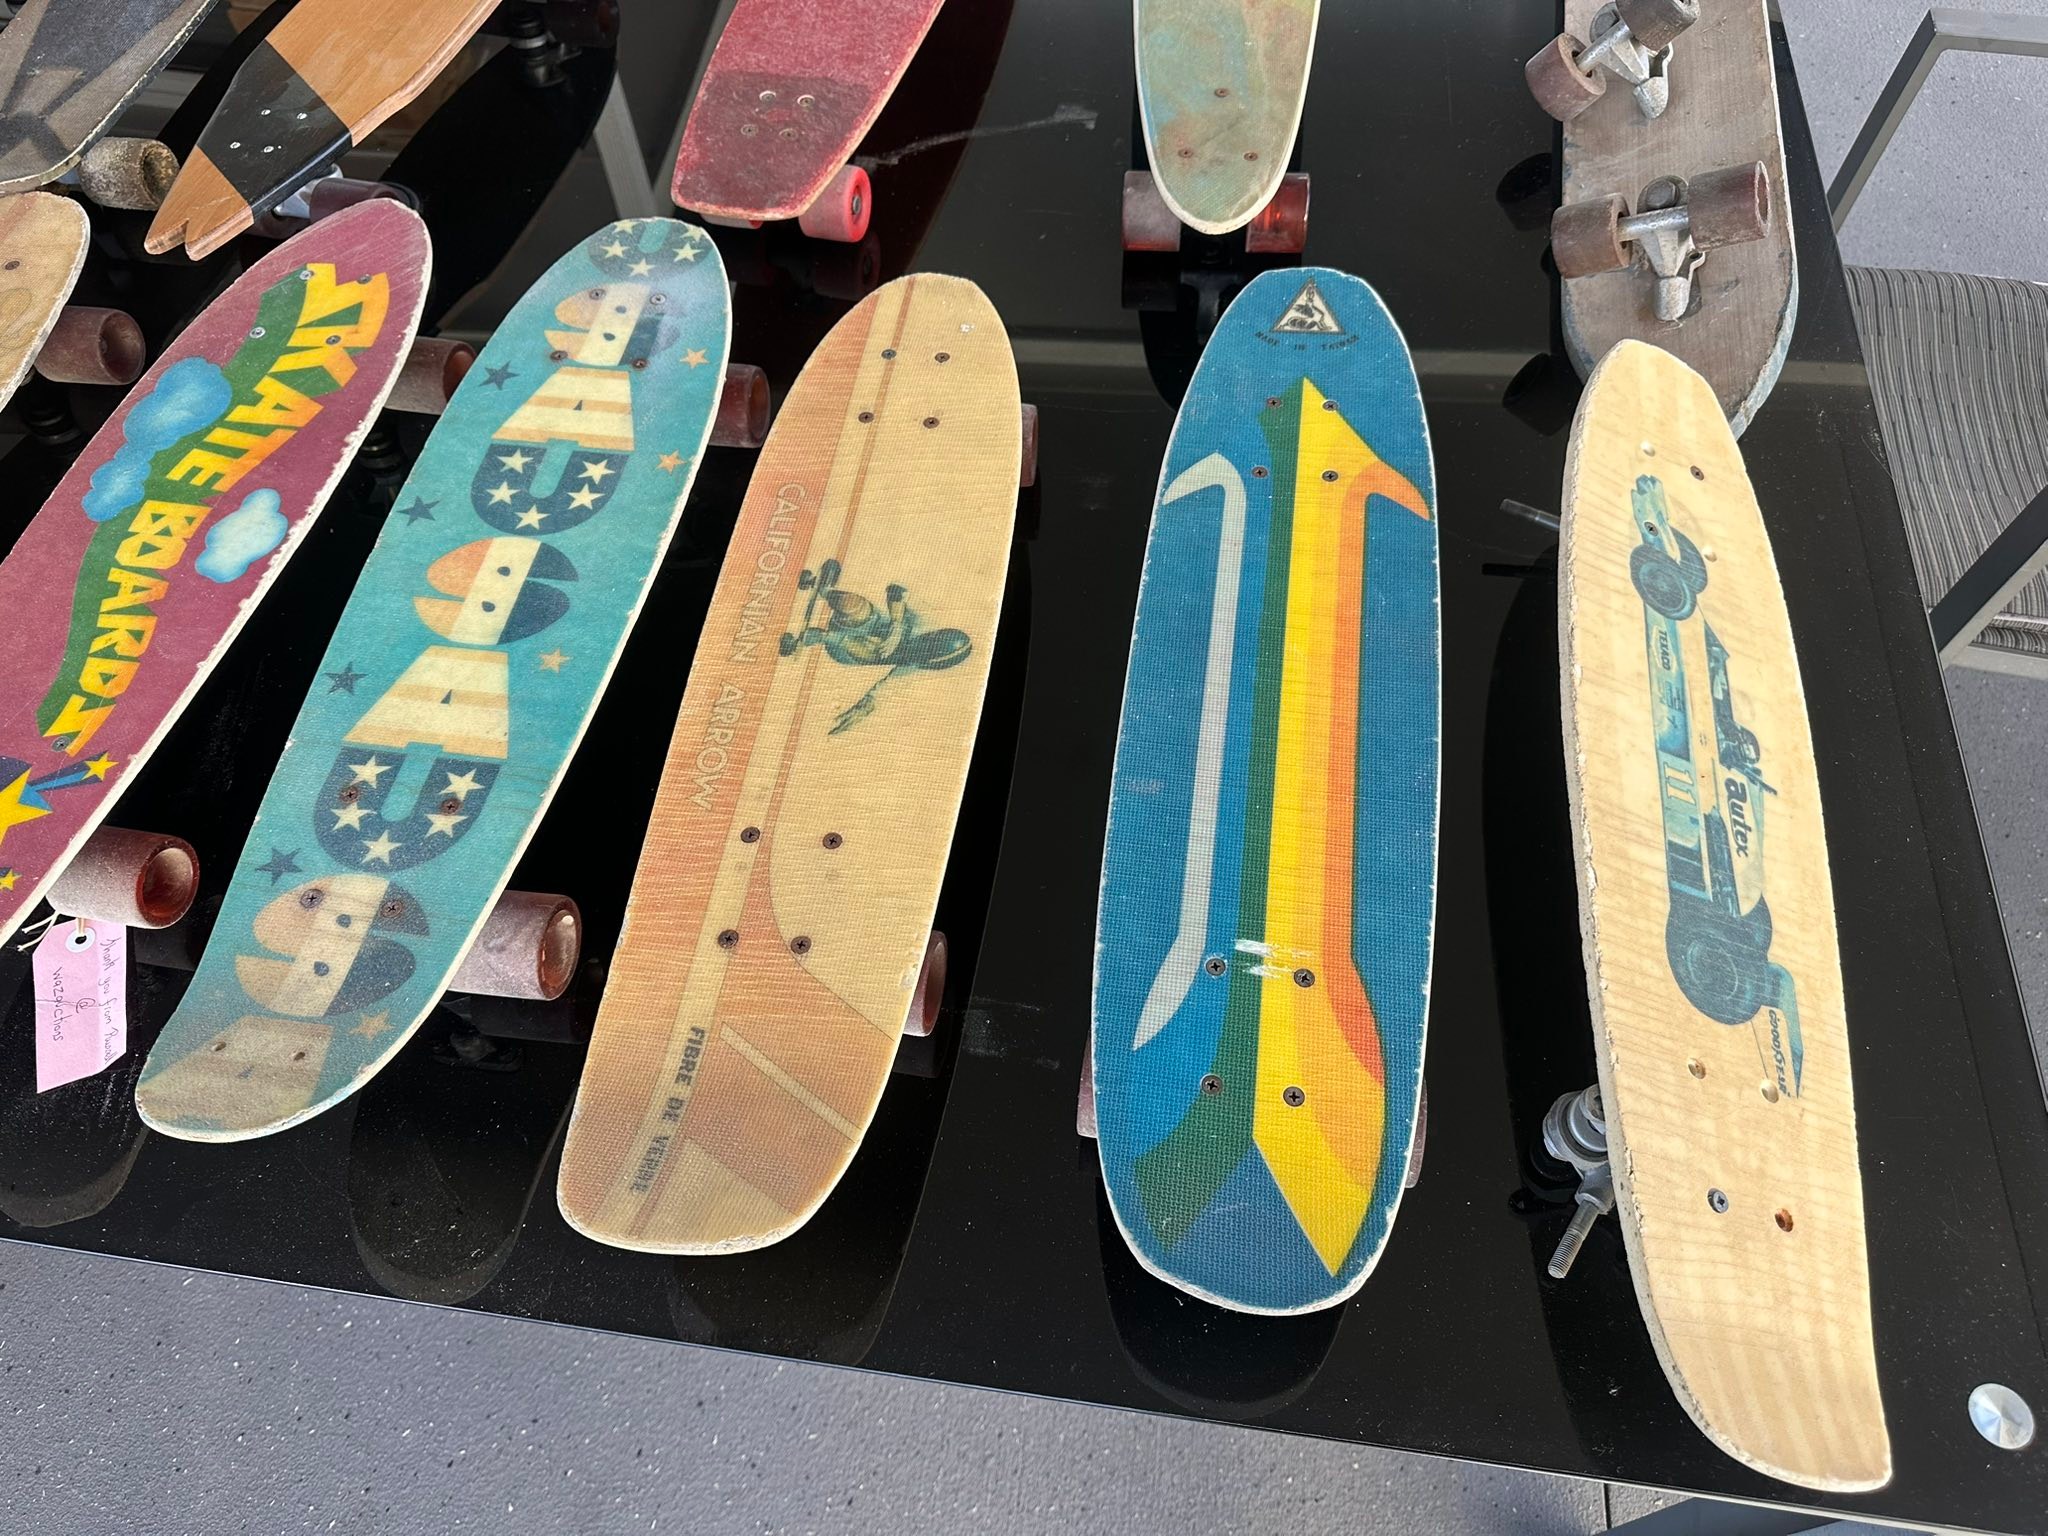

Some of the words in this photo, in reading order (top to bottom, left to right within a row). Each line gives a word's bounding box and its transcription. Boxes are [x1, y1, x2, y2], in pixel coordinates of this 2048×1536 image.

[1254, 331, 1280, 346] MADE
[1294, 343, 1306, 351] IN
[1321, 334, 1360, 350] TAIWAN
[729, 481, 807, 666] CALIFORNIAN
[1658, 629, 1671, 671] TEXACO
[684, 681, 746, 812] ARROW
[1663, 761, 1697, 806] 11
[1724, 777, 1752, 858] autex
[100, 937, 122, 972] Thank
[98, 975, 114, 995] you
[98, 997, 118, 1025] from
[104, 1026, 120, 1065] Russell
[674, 1025, 706, 1087] FIBRE
[661, 1097, 685, 1123] DE
[630, 1135, 671, 1195] VERRE
